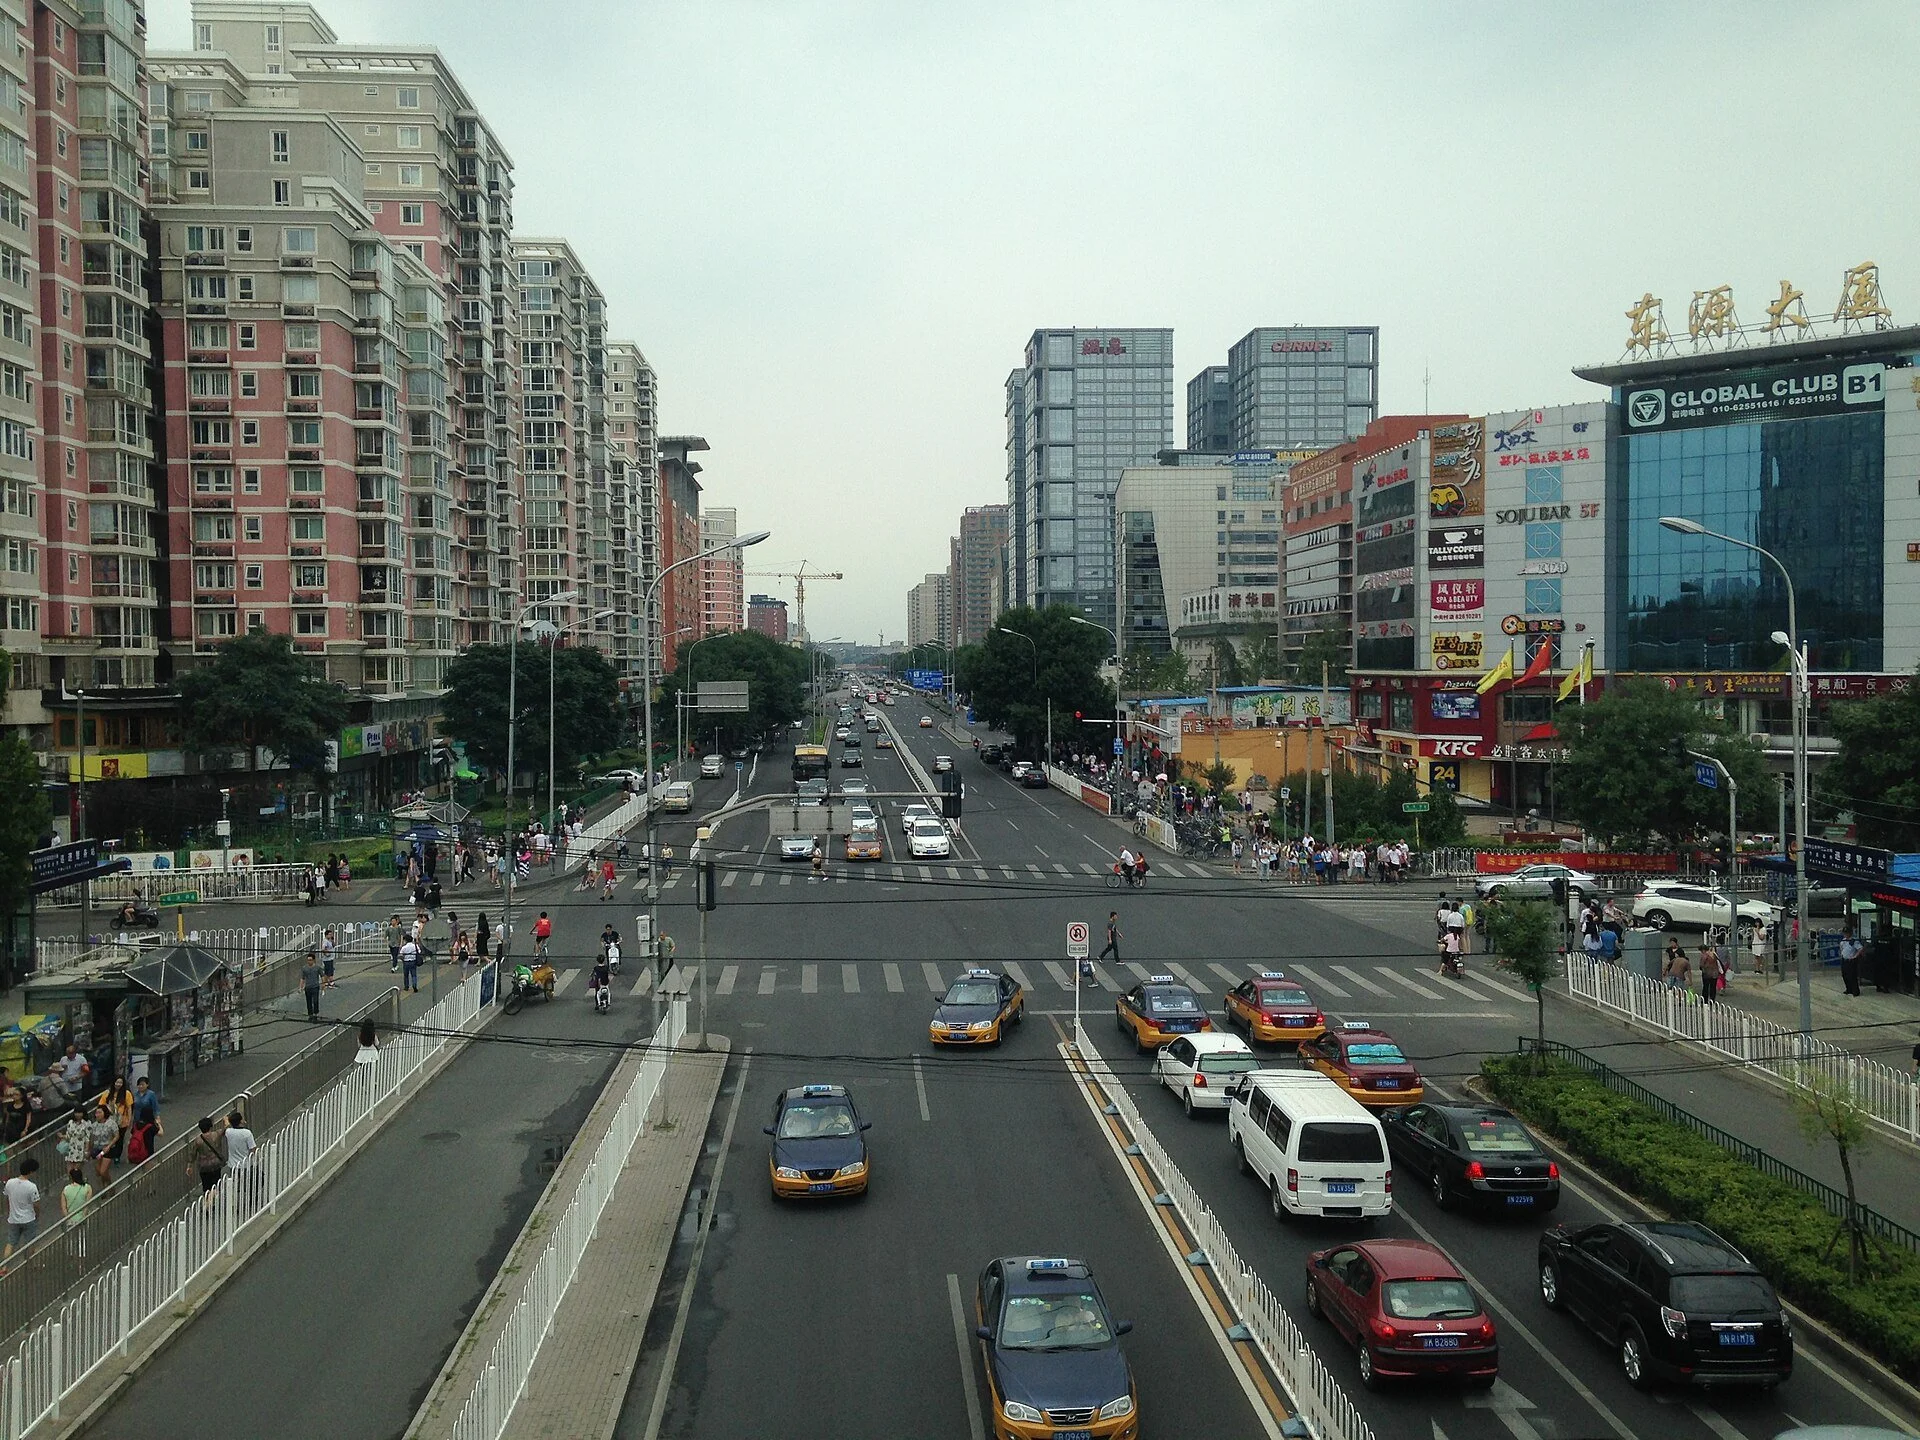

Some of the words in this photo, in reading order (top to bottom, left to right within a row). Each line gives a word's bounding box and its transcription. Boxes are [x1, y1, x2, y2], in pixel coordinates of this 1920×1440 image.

[1271, 340, 1333, 353] CERNET
[1671, 383, 1764, 408] GLOBAL
[1772, 374, 1838, 397] CLUB
[1848, 373, 1882, 395] B1
[1712, 399, 1780, 414] 010-62551616
[1789, 393, 1838, 405] 62551953
[1496, 507, 1536, 525] SOJU
[1539, 505, 1571, 520] BAR
[1580, 503, 1600, 518] 5F
[1428, 546, 1453, 555] TALLY
[1453, 544, 1484, 554] COFFEE
[1228, 592, 1275, 608] 清华园
[1436, 596, 1447, 604] SPA
[1453, 595, 1479, 603] BEAUTY
[1433, 635, 1482, 656] 포장마차
[1445, 680, 1465, 688] Pizza
[1433, 741, 1477, 756] KFC
[1433, 766, 1455, 780] 24
